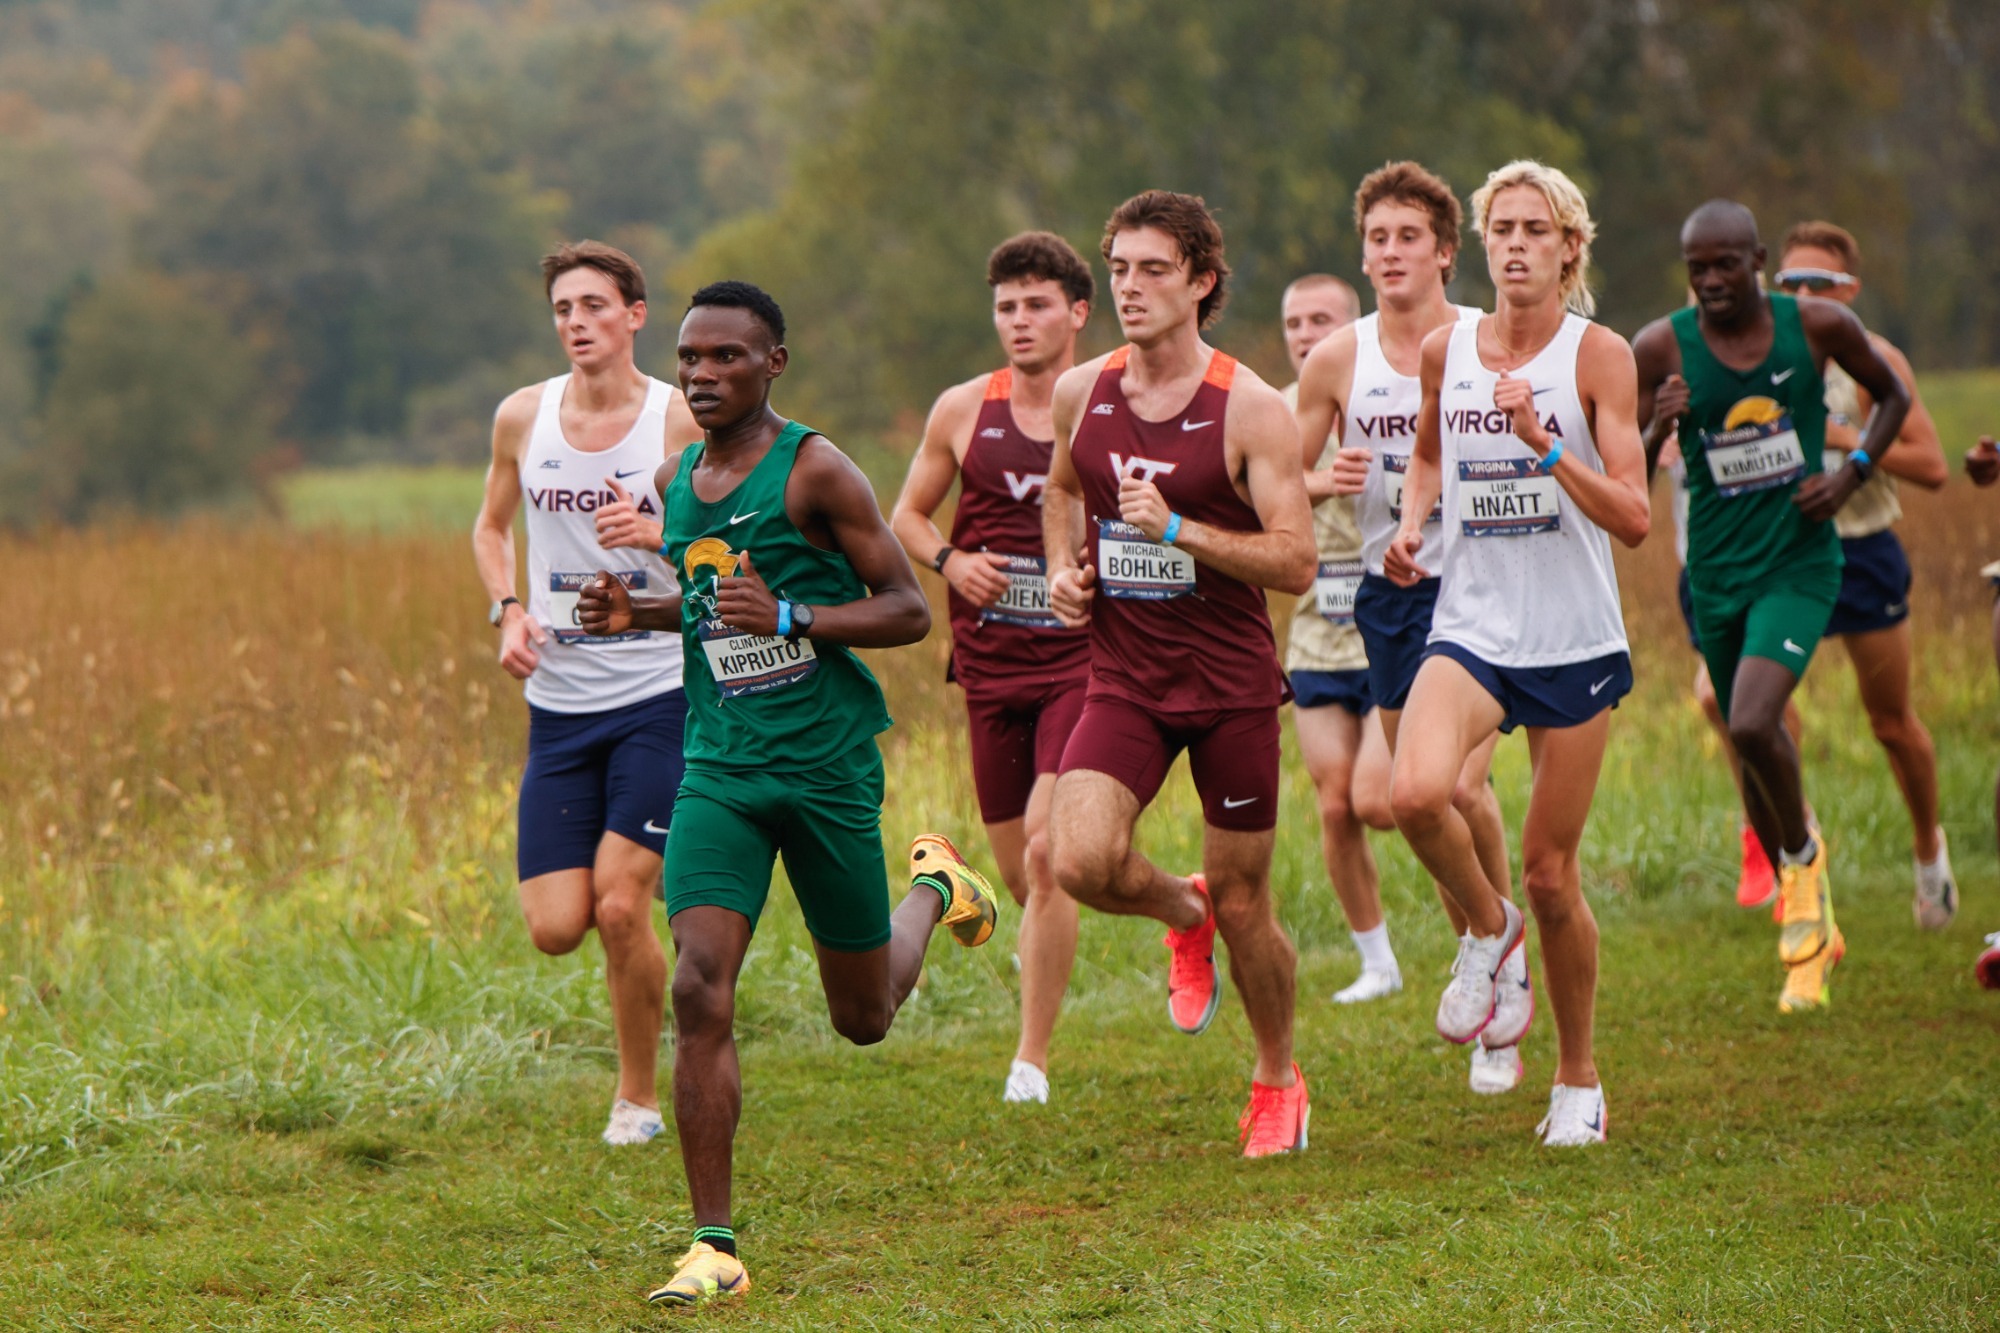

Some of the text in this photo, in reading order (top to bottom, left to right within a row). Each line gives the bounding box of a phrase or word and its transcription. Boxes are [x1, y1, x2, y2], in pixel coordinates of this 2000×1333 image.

[1091, 403, 1115, 415] ACC
[1445, 409, 1564, 438] VIRGIA
[539, 460, 562, 469] ACC
[1466, 461, 1516, 472] VIRGINIA
[1721, 447, 1793, 476] KIMUTAI
[1491, 481, 1517, 494] LUKE
[529, 487, 657, 516] VIRGINA
[1472, 493, 1542, 517] HNATT
[1110, 521, 1145, 535] VIRGIN
[1122, 544, 1166, 558] MICHAEL
[1108, 556, 1185, 580] BOHLKE
[560, 574, 598, 586] VIRGIN
[1012, 577, 1045, 588] AMUEL
[729, 635, 776, 651] CLINTON
[718, 642, 801, 675] KIPRUTO
